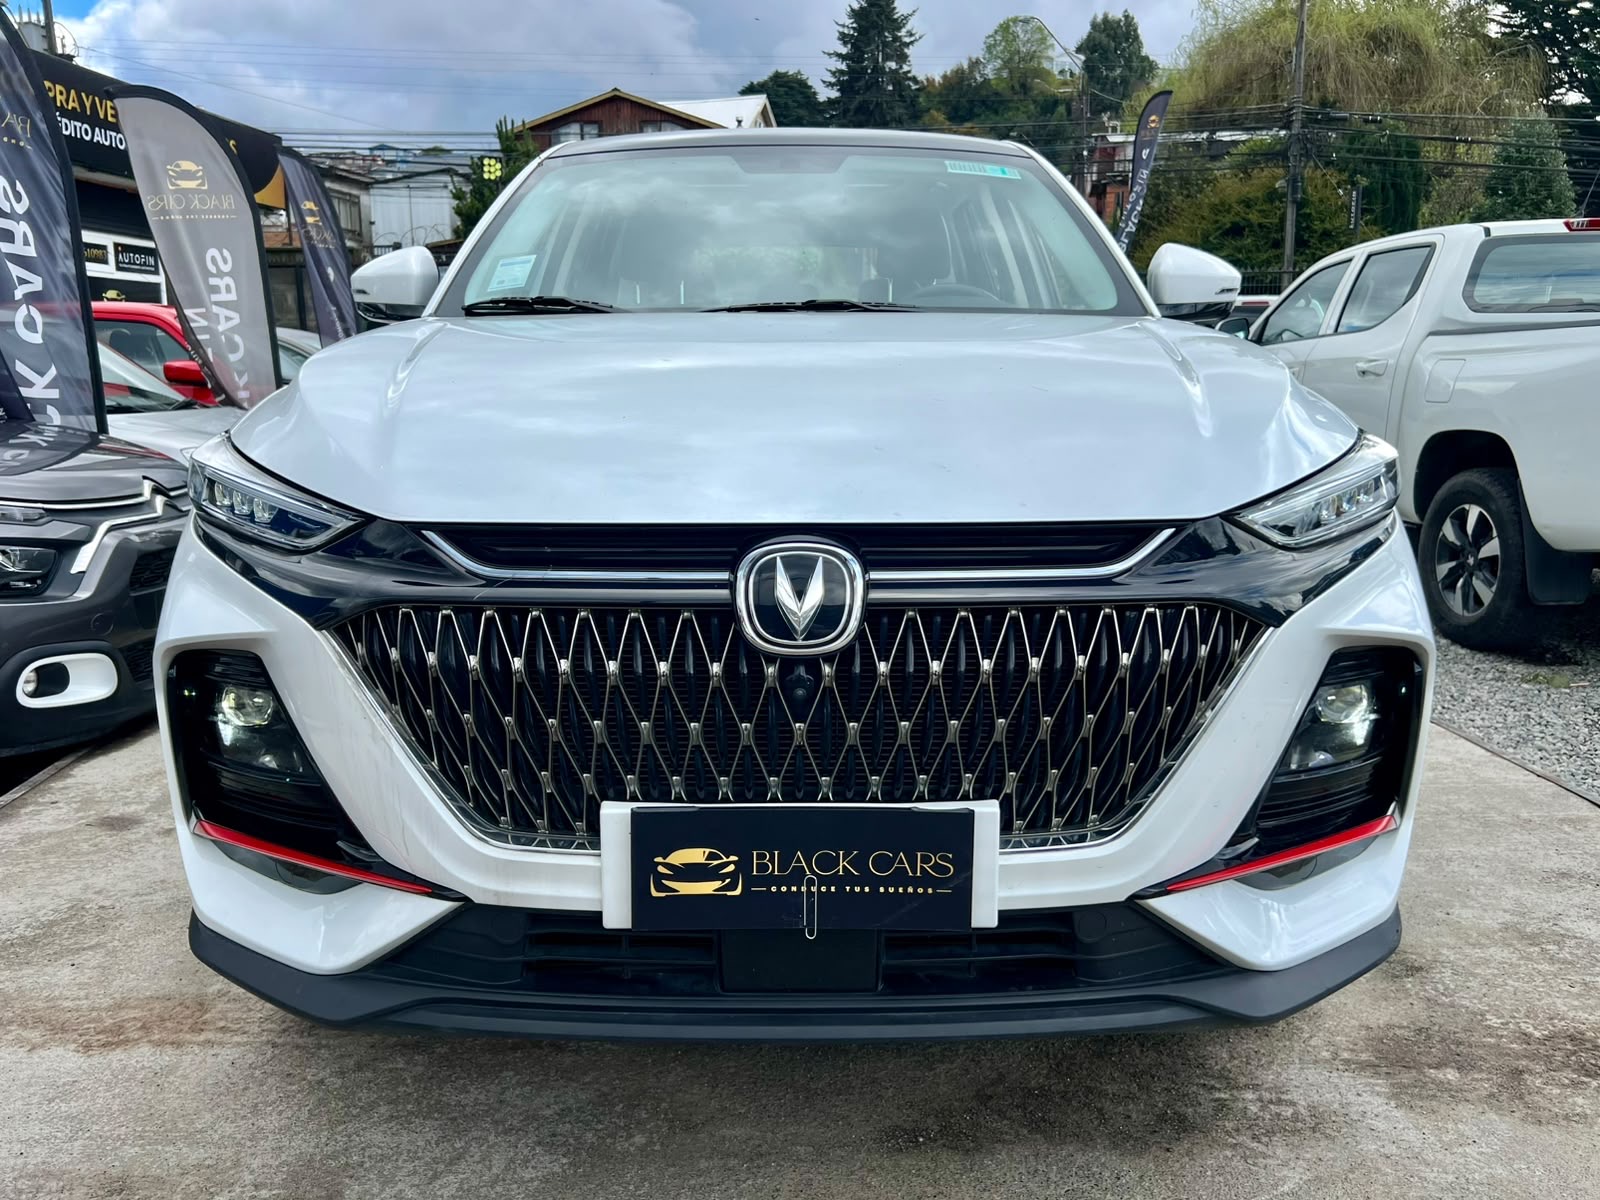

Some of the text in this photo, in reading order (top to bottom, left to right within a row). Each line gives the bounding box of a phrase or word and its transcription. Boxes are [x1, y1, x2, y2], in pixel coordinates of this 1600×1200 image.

[81, 92, 93, 115] Y
[93, 126, 126, 150] AUTO
[118, 251, 156, 266] AUTOFIN
[751, 850, 954, 878] BLACK CARS
[879, 885, 934, 894] SUEÑOS
